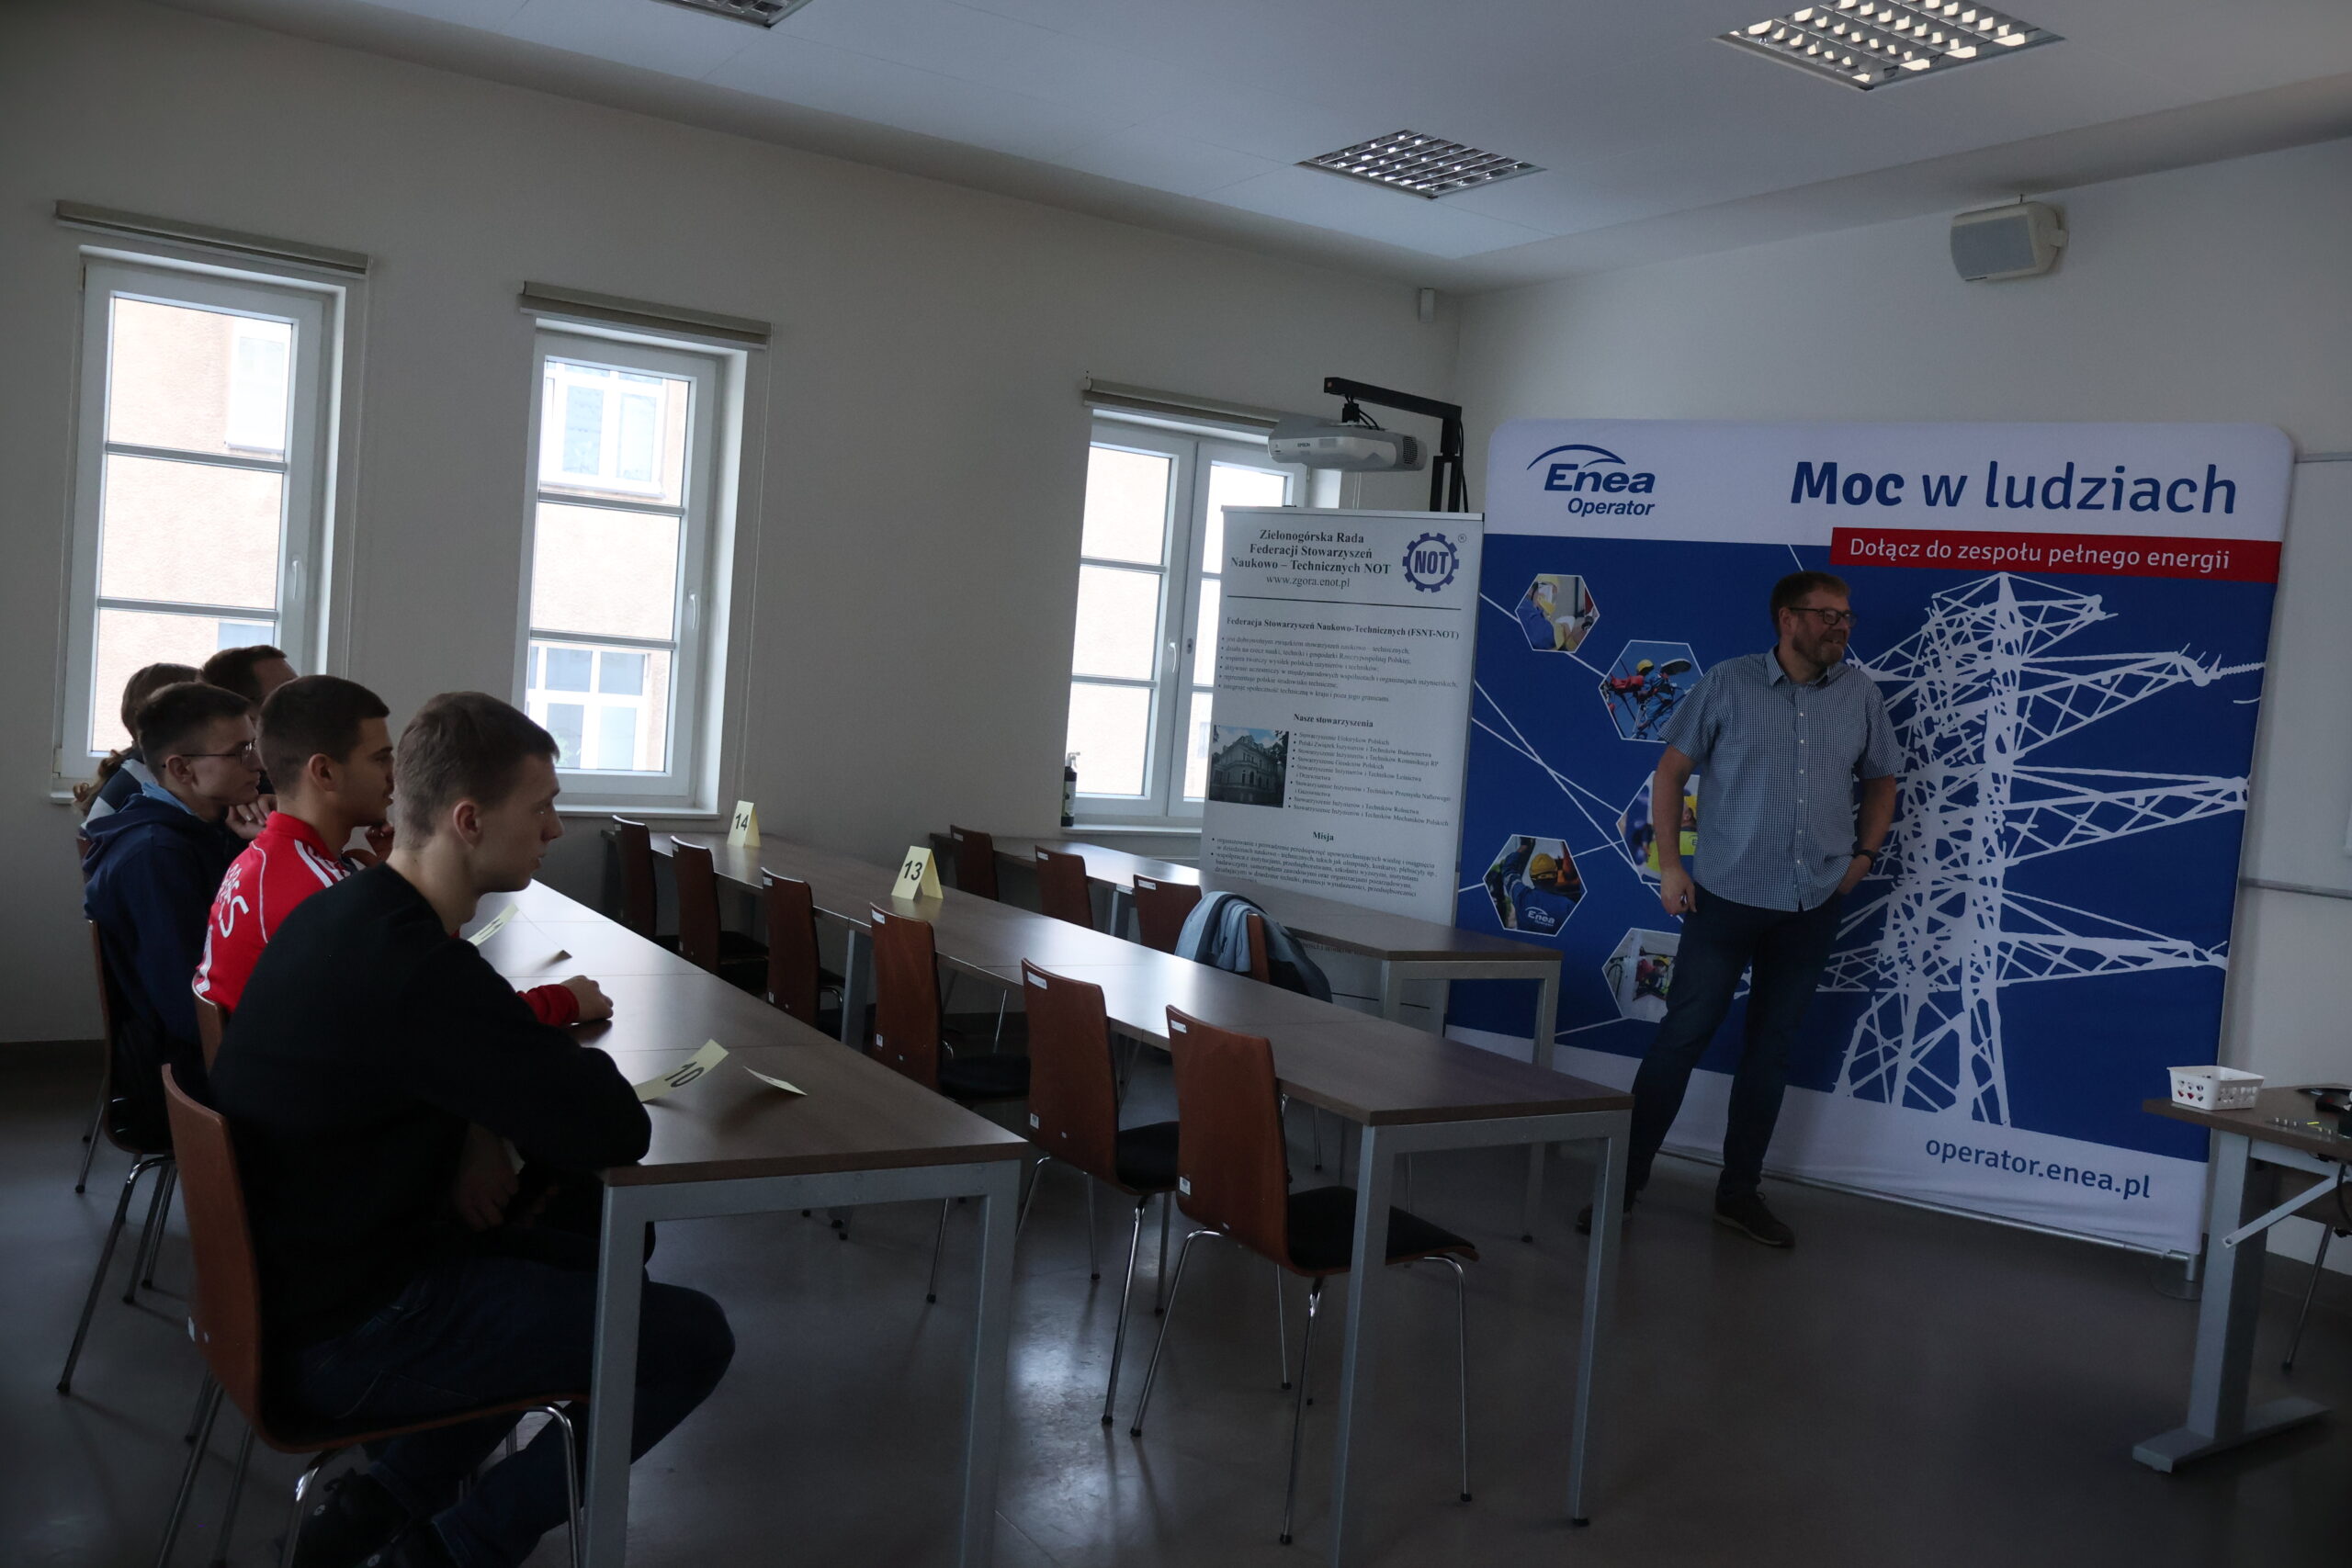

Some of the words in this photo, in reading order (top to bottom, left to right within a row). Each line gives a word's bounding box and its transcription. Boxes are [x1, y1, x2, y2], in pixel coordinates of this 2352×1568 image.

[1544, 463, 1656, 494] Enea
[1790, 461, 1905, 506] Moc
[1922, 474, 1968, 508] w
[1985, 460, 2236, 514] ludziach
[1567, 498, 1655, 517] Operator
[1260, 529, 1333, 544] Zielonogórska
[1337, 532, 1364, 544] Rada
[1250, 544, 1298, 558] Federacji
[1301, 546, 1373, 560] Stowarzyszeń
[1849, 537, 1919, 561] Dołącz
[1926, 538, 1951, 559] do
[1957, 540, 2041, 568] zespołu
[2048, 544, 2140, 570] pełnego
[2146, 549, 2230, 574] energii
[1231, 558, 1278, 569] Naukowo
[1291, 559, 1361, 574] Technicznych
[1364, 563, 1391, 574] NOT
[1414, 550, 1449, 575] NOT
[1266, 577, 1351, 590] www.zgora.enot.pl
[1227, 617, 1262, 628] Federacja
[1264, 619, 1315, 631] Stowarzyszeń
[1317, 623, 1407, 637] Naukowo-Technicznych
[1408, 628, 1459, 641] (FSNT-NOT)
[1294, 714, 1315, 723] Nasze
[1316, 716, 1374, 728] stowarzyszenia
[734, 813, 749, 831] 14
[1312, 830, 1334, 841] Misja
[904, 861, 922, 881] 13
[1527, 910, 1555, 924] Enea
[664, 1061, 705, 1088] 10
[1925, 1139, 2151, 1200] operator.enea.pl
